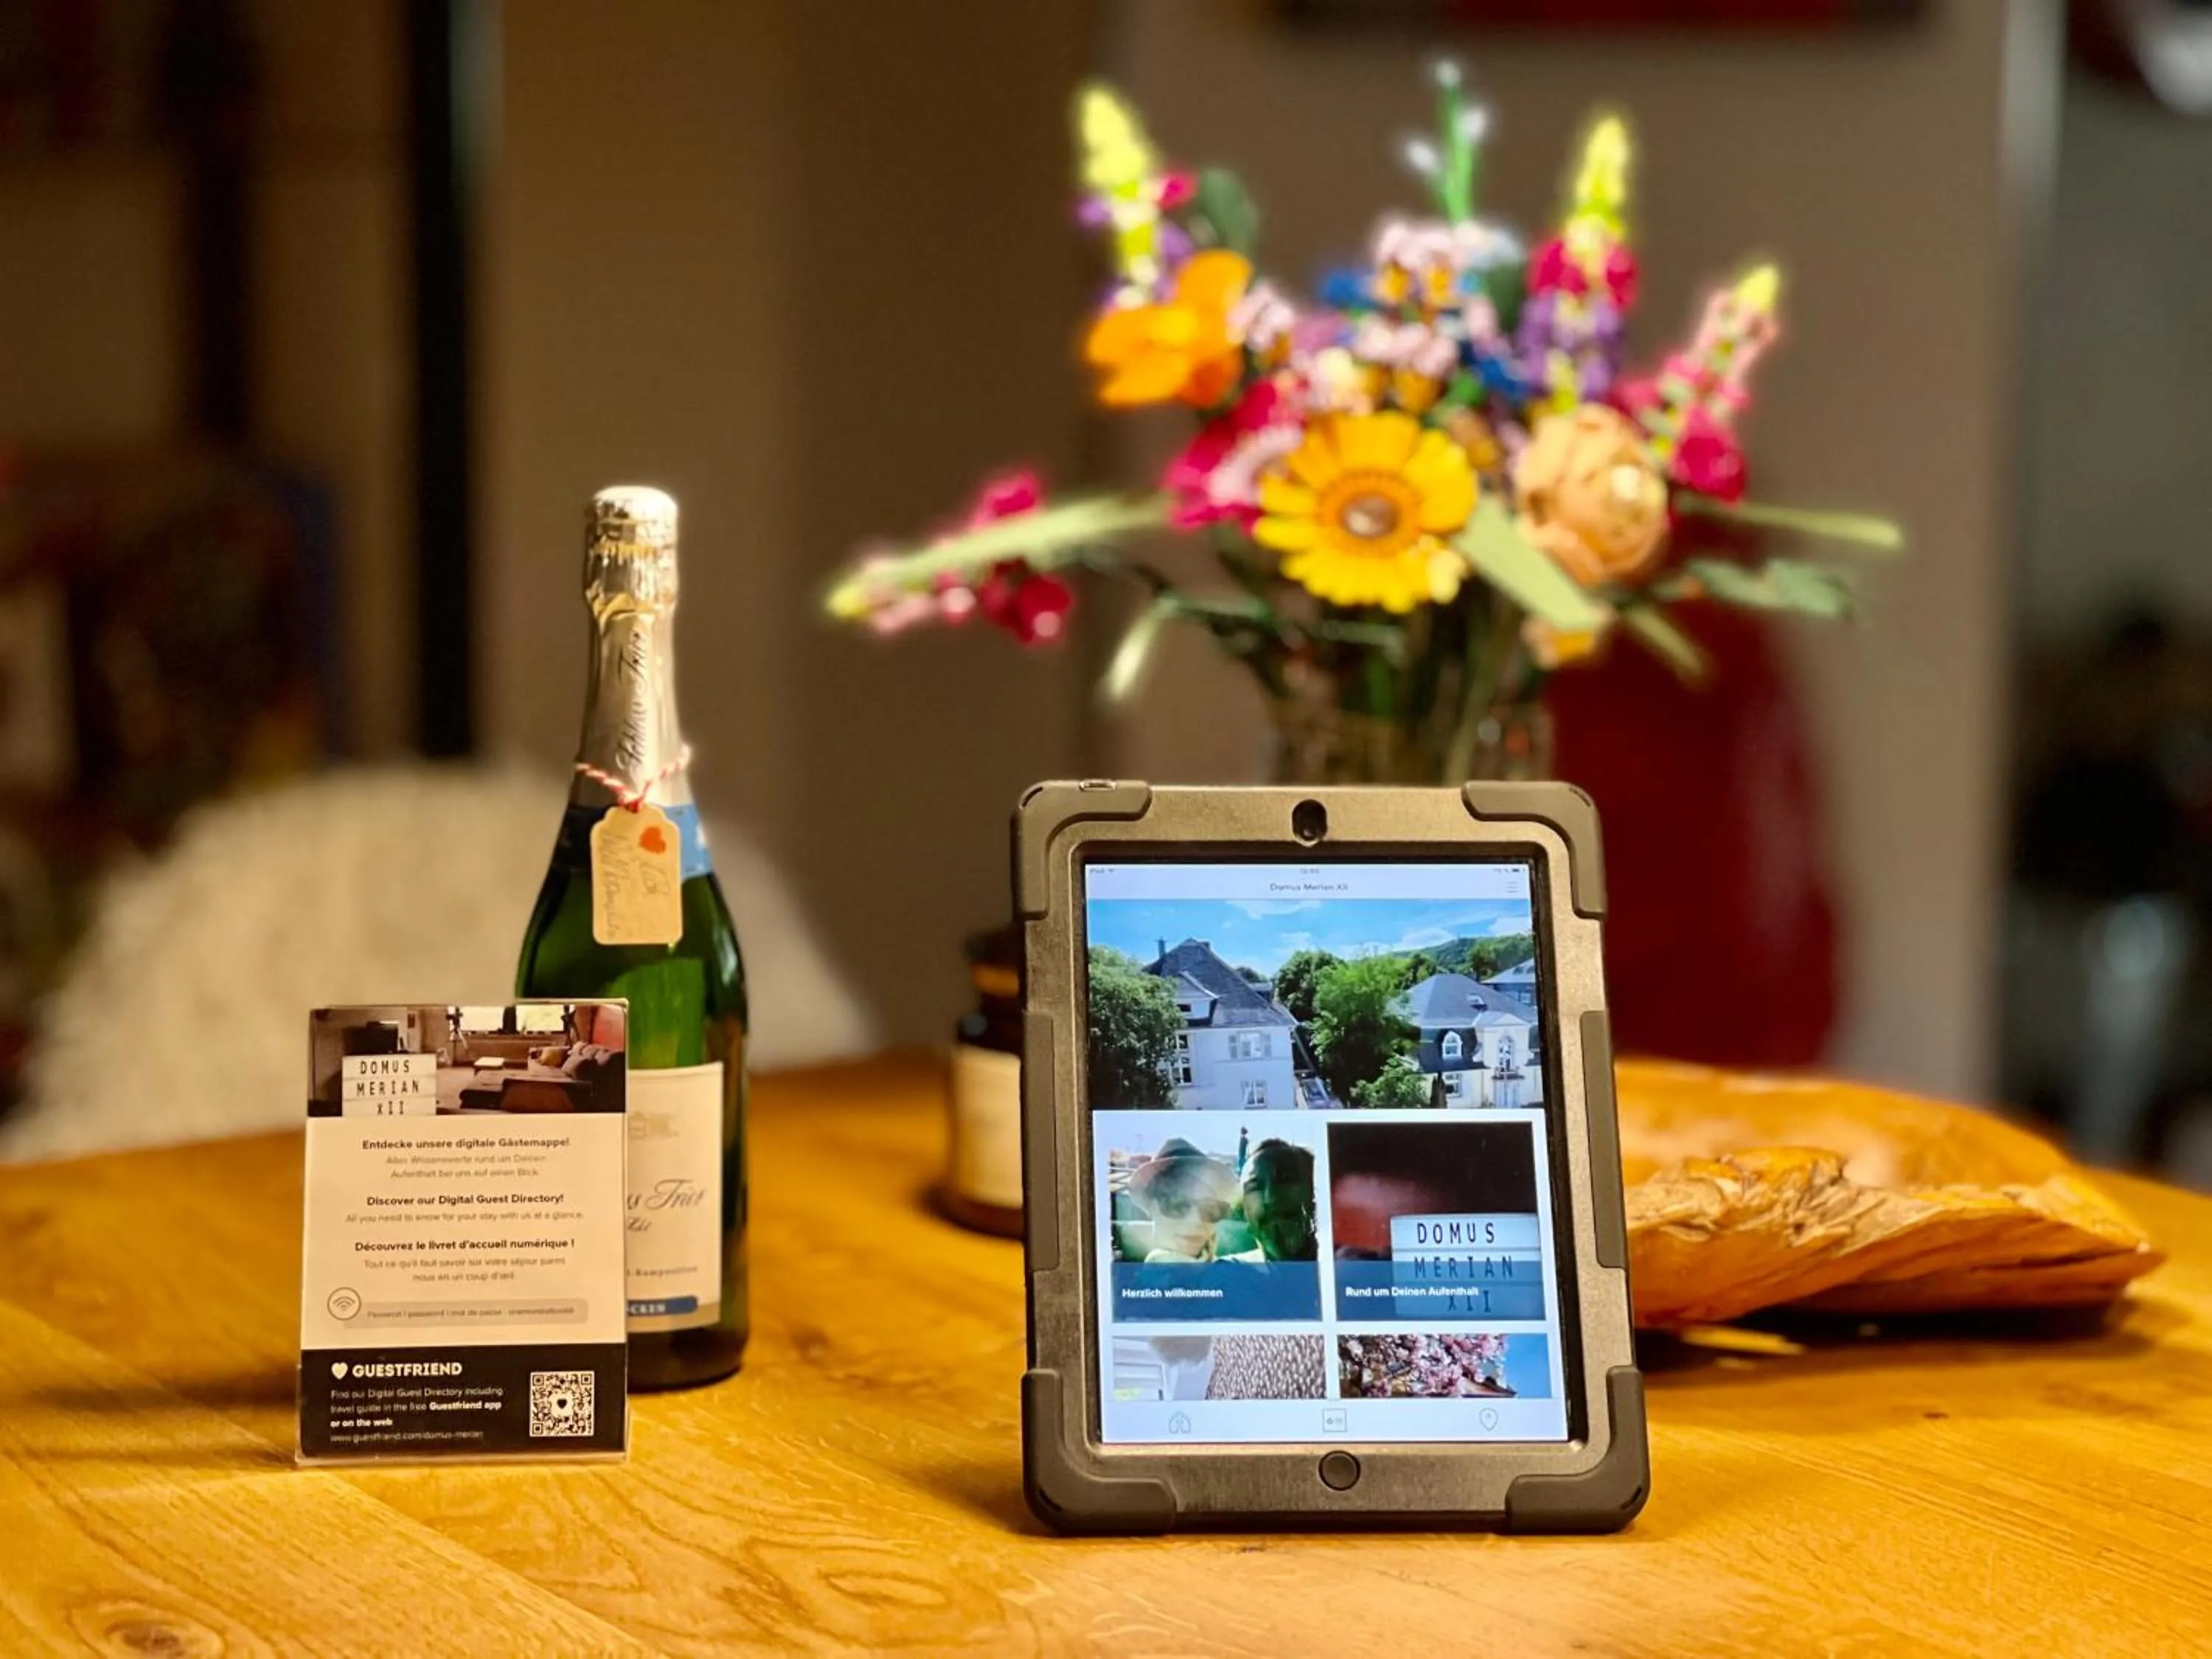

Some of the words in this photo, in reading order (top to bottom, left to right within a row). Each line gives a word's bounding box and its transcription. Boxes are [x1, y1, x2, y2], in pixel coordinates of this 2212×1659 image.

[1270, 883, 1301, 891] Domus
[1304, 883, 1334, 891] Merian
[361, 1060, 409, 1074] DOMUS
[357, 1079, 419, 1096] MERIAN
[377, 1101, 403, 1115] XII
[362, 1140, 412, 1150] Entdecke
[455, 1138, 495, 1150] digitale
[367, 1196, 414, 1206] Discover
[439, 1194, 473, 1206] Digital
[476, 1194, 508, 1203] Guest
[511, 1194, 563, 1204] Directory!
[1417, 1222, 1495, 1244] DOMUS
[355, 1242, 412, 1251] Découvrez
[428, 1242, 456, 1250] livret
[510, 1239, 568, 1251] numérique
[1414, 1256, 1513, 1278] MERIAN
[1121, 1288, 1162, 1298] Herzlich
[1164, 1288, 1223, 1298] willkommen
[1346, 1287, 1371, 1296] Rund
[1391, 1287, 1427, 1296] Deinen
[1427, 1286, 1478, 1296] Aufenthalt
[630, 1303, 666, 1314] CKEN
[352, 1362, 462, 1377] GUESTFRIEND
[331, 1390, 349, 1398] Find
[368, 1388, 394, 1399] Digital
[397, 1388, 422, 1397] Guest
[424, 1387, 462, 1397] Directory
[465, 1386, 504, 1397] including
[393, 1402, 407, 1411] the
[409, 1402, 427, 1410] free
[428, 1401, 482, 1410] Guestfriend
[484, 1402, 501, 1411] app
[356, 1418, 371, 1426] the
[373, 1417, 393, 1425] web
